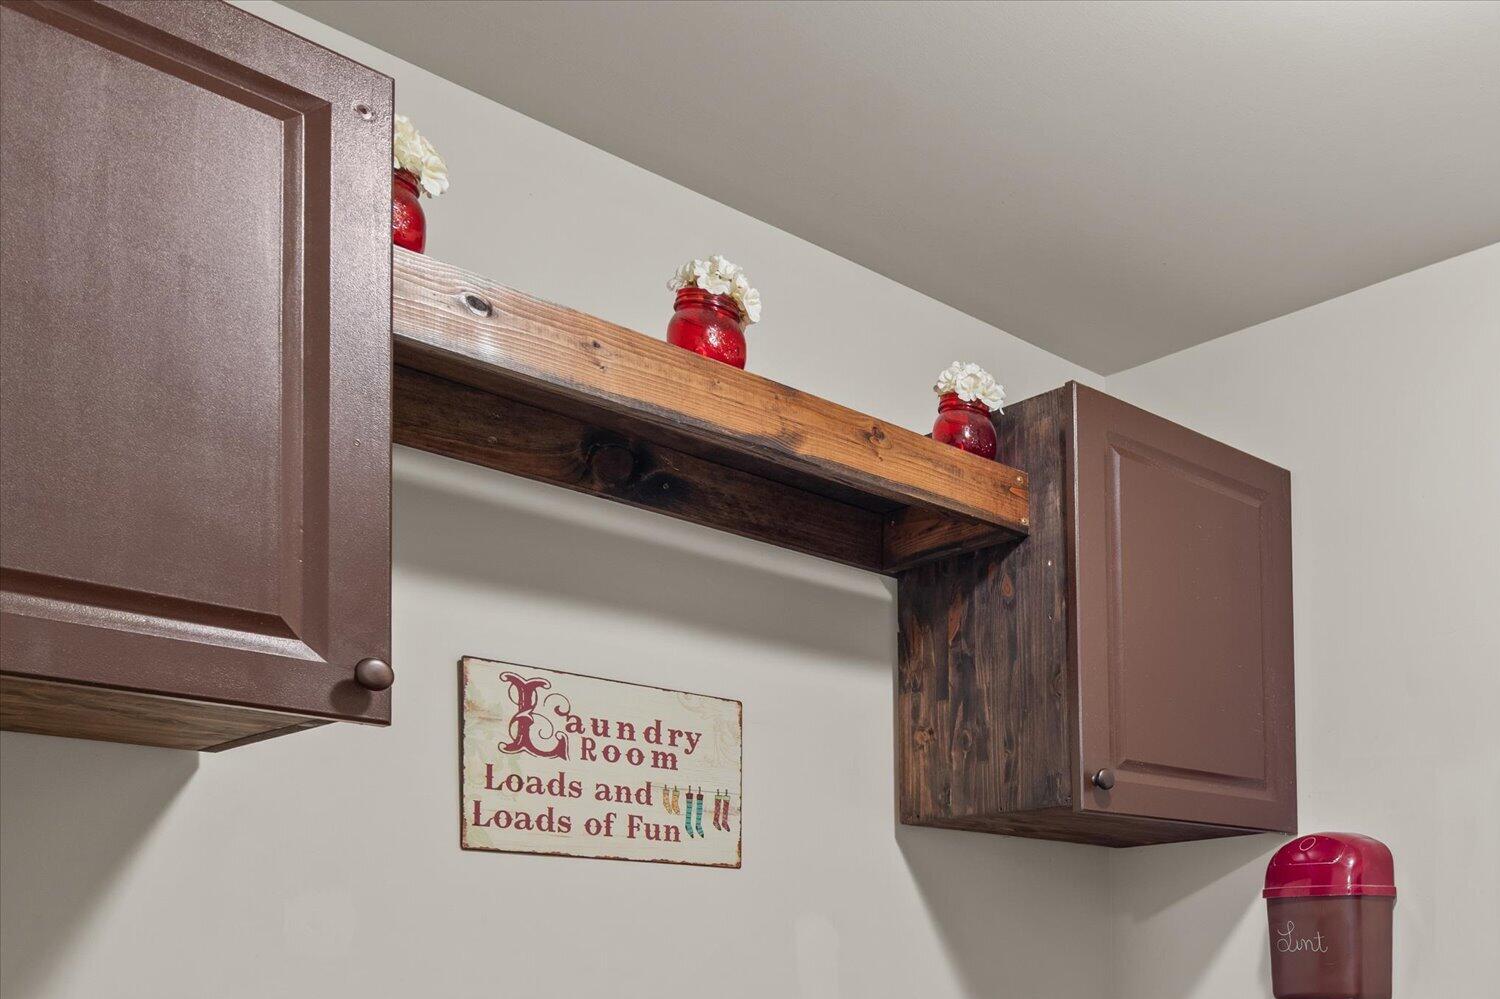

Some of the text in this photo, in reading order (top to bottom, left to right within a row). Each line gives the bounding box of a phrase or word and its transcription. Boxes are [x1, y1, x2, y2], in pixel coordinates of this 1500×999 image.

[498, 671, 702, 761] Laundry
[484, 763, 653, 806] Loads and
[472, 800, 682, 843] Loads of Fun
[1276, 920, 1329, 953] Lint
